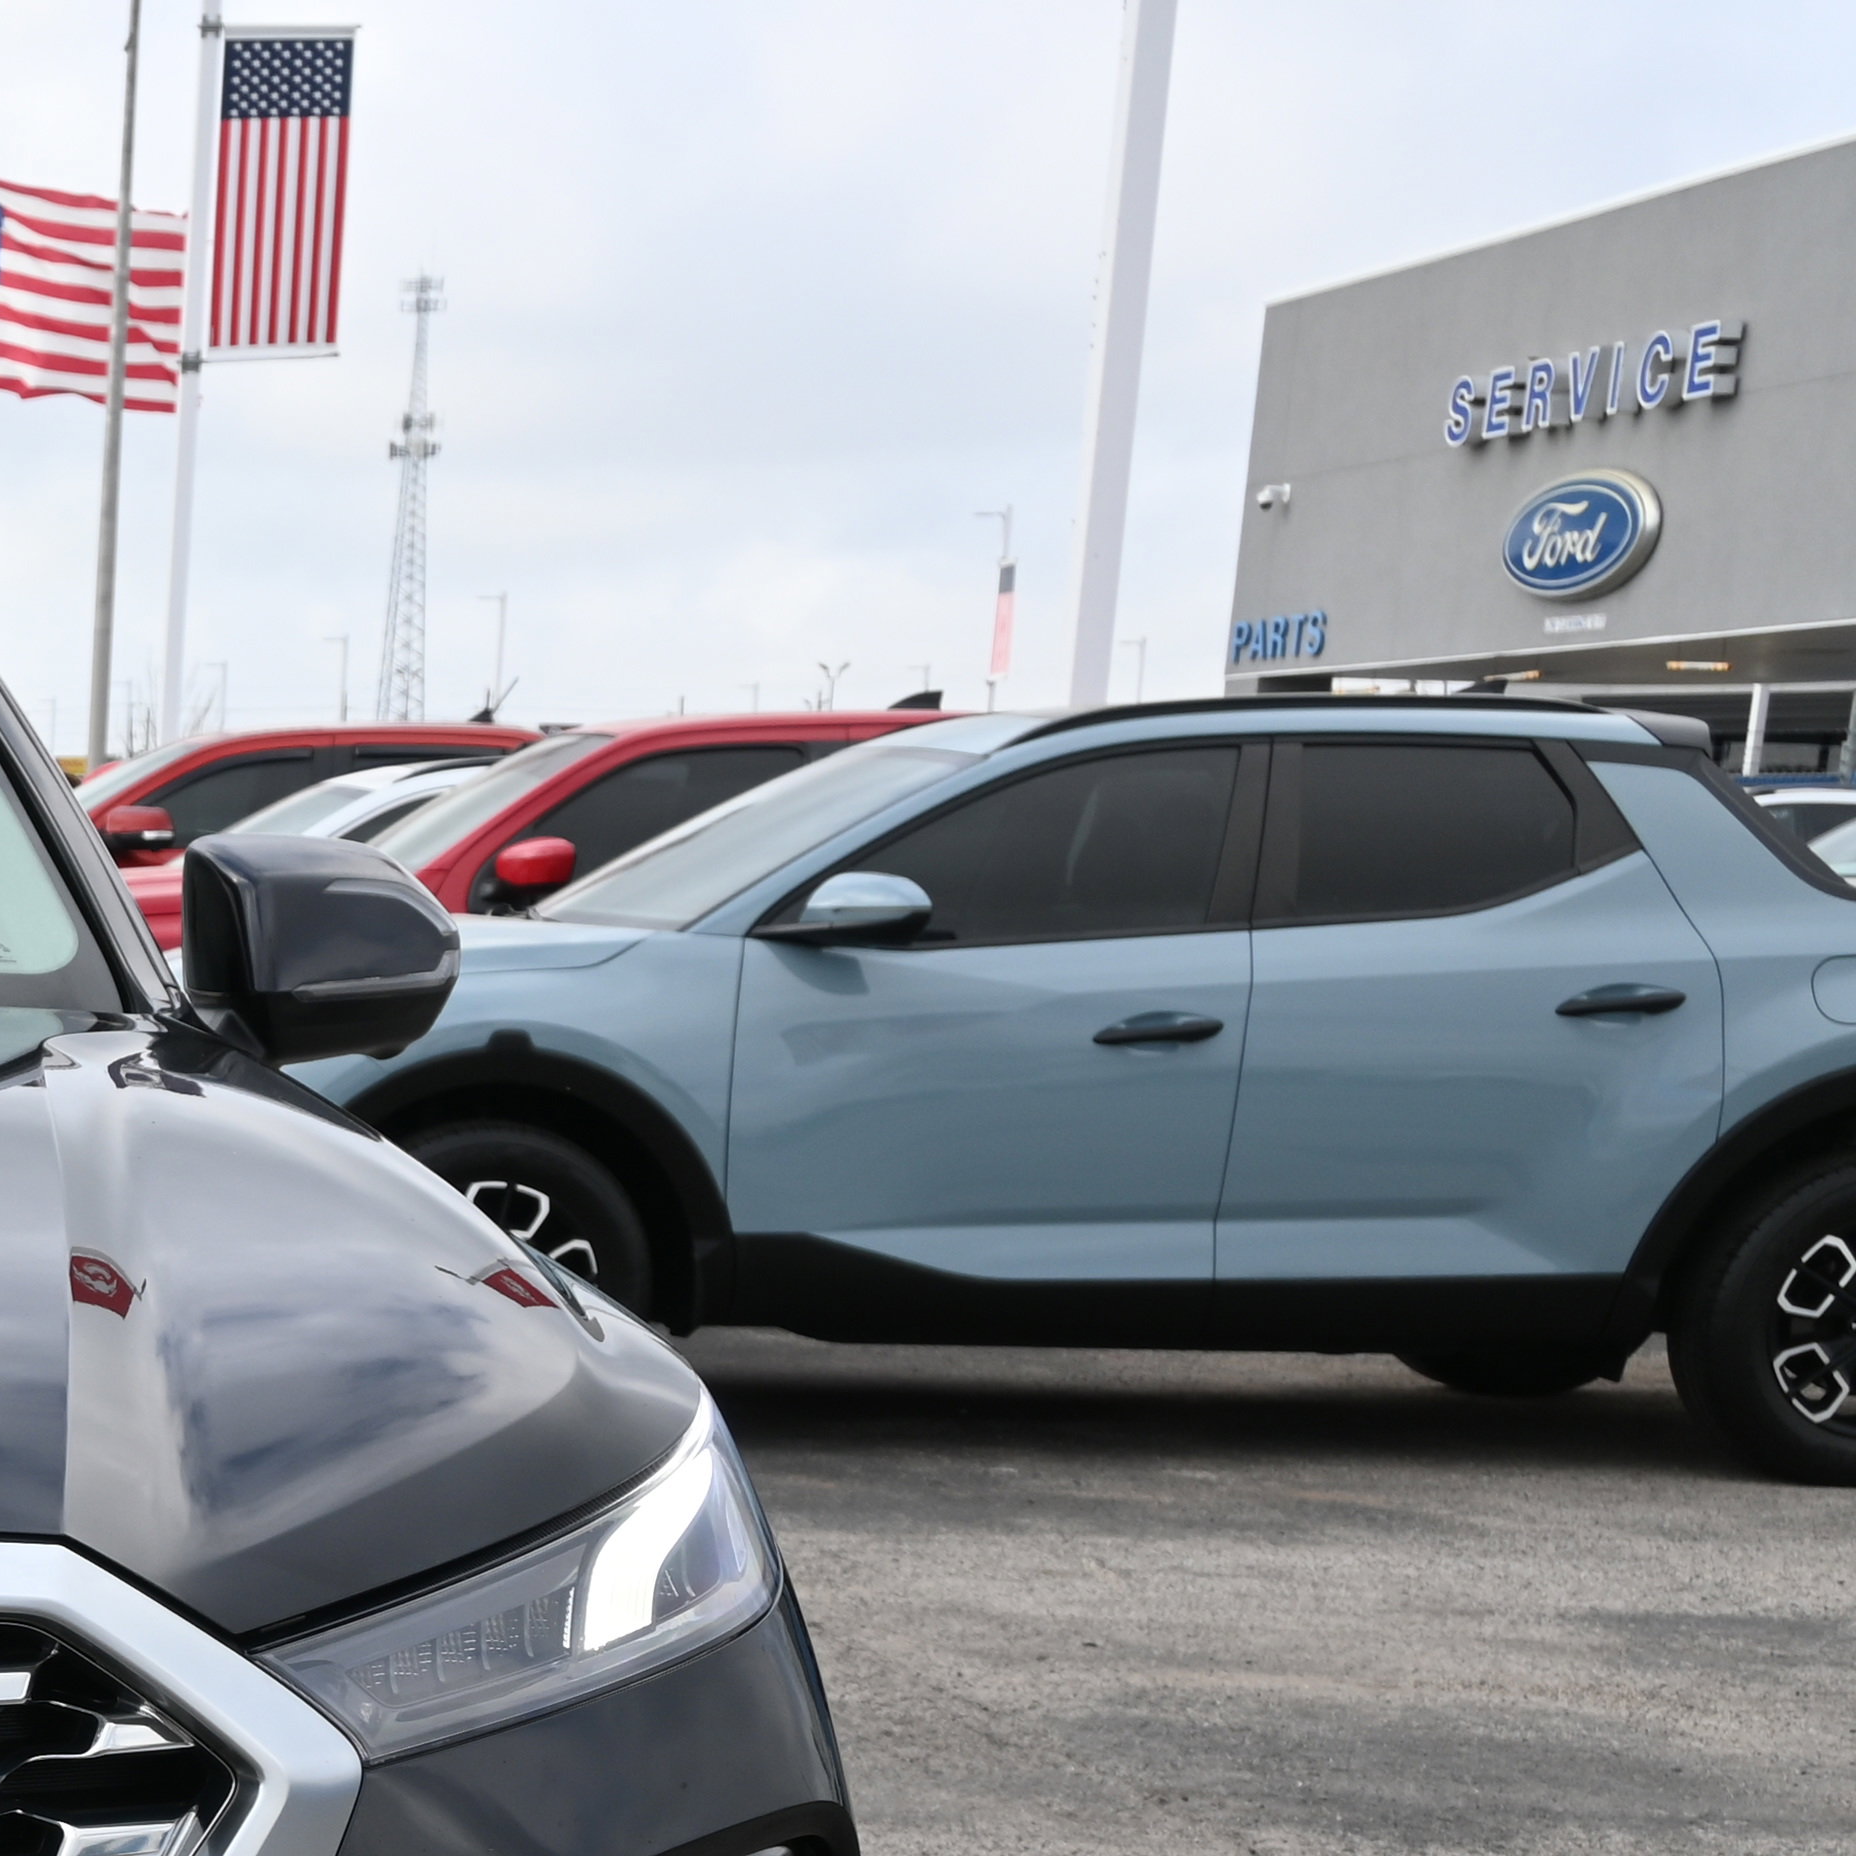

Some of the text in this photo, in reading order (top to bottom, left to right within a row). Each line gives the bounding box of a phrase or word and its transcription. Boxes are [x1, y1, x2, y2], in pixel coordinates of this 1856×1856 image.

[1444, 319, 1722, 448] SERVICE
[1522, 500, 1609, 572] Ford
[1232, 608, 1328, 665] PARTS
